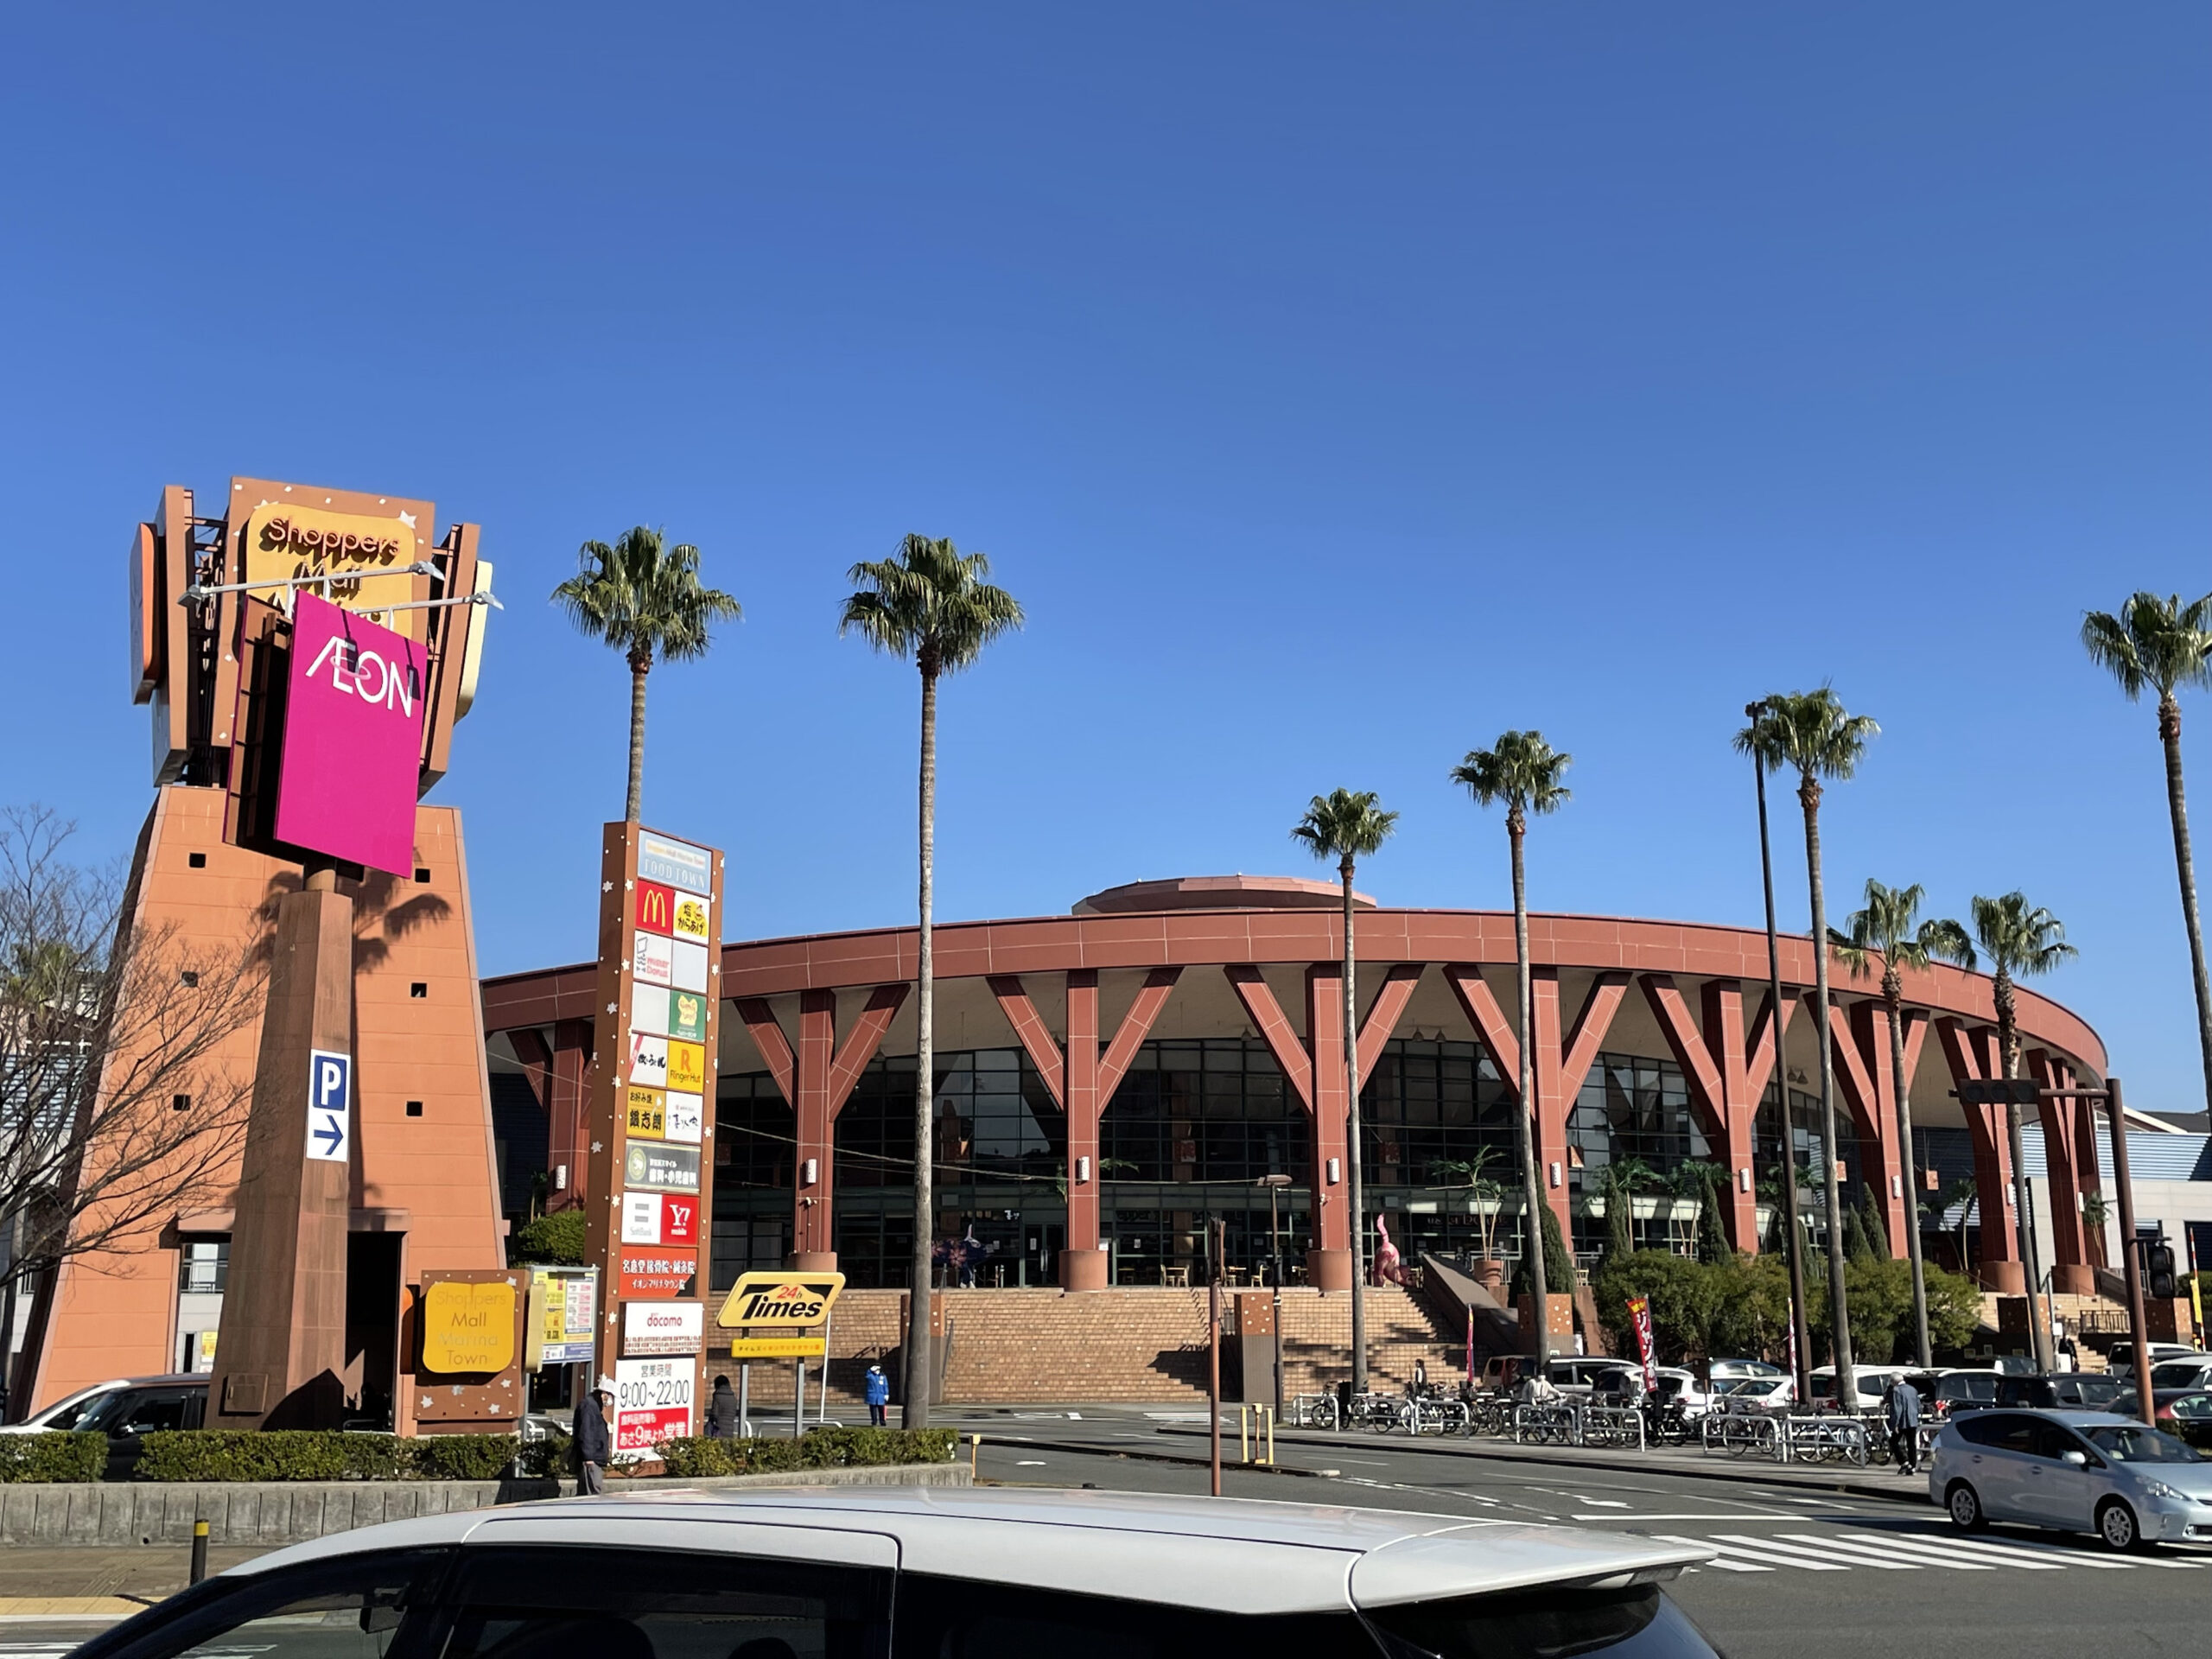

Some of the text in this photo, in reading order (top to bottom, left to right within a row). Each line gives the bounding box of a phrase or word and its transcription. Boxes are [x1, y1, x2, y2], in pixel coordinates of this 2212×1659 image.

[268, 517, 400, 558] Shoppers
[321, 1061, 341, 1105] P
[741, 1294, 823, 1320] Times
[451, 1312, 486, 1327] Mall
[647, 1313, 682, 1327] docomo
[447, 1350, 488, 1365] Town
